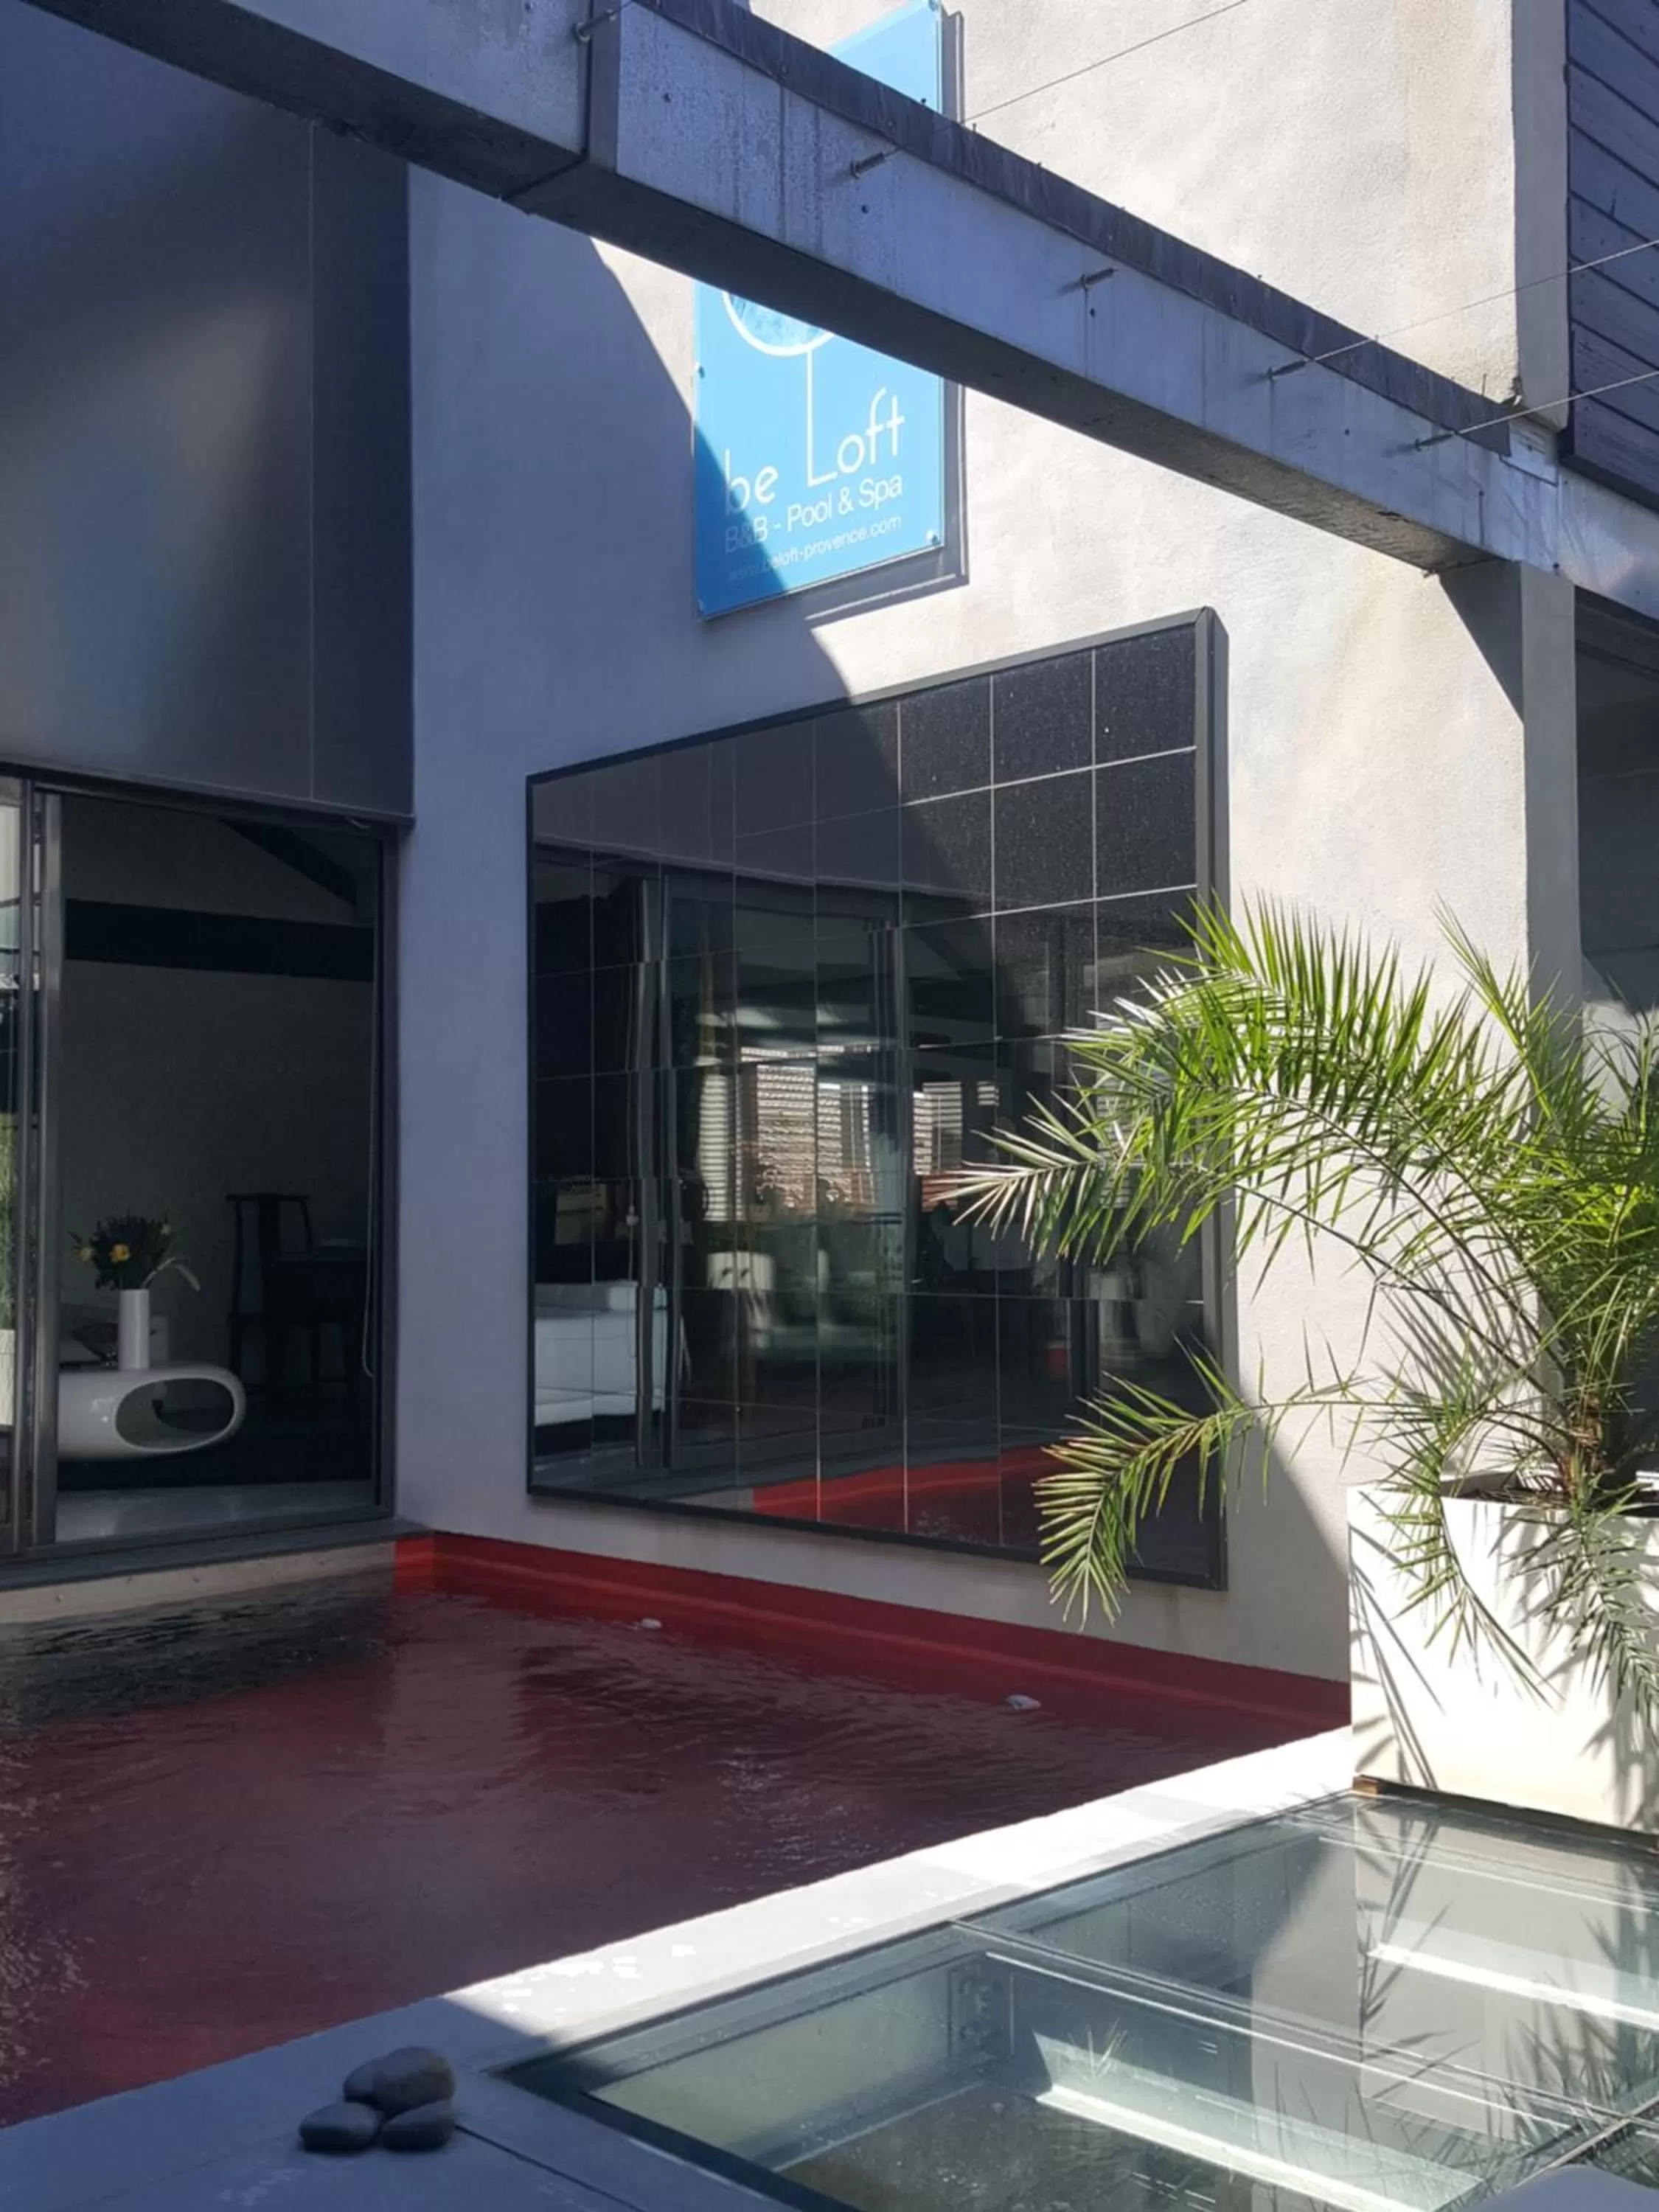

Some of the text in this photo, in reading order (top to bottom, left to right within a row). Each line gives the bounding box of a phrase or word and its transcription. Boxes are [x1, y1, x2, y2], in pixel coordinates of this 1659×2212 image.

[724, 352, 905, 515] be Loft
[725, 515, 768, 554] B&B
[787, 493, 833, 532] Pool
[838, 487, 853, 515] &
[858, 474, 903, 510] Spa
